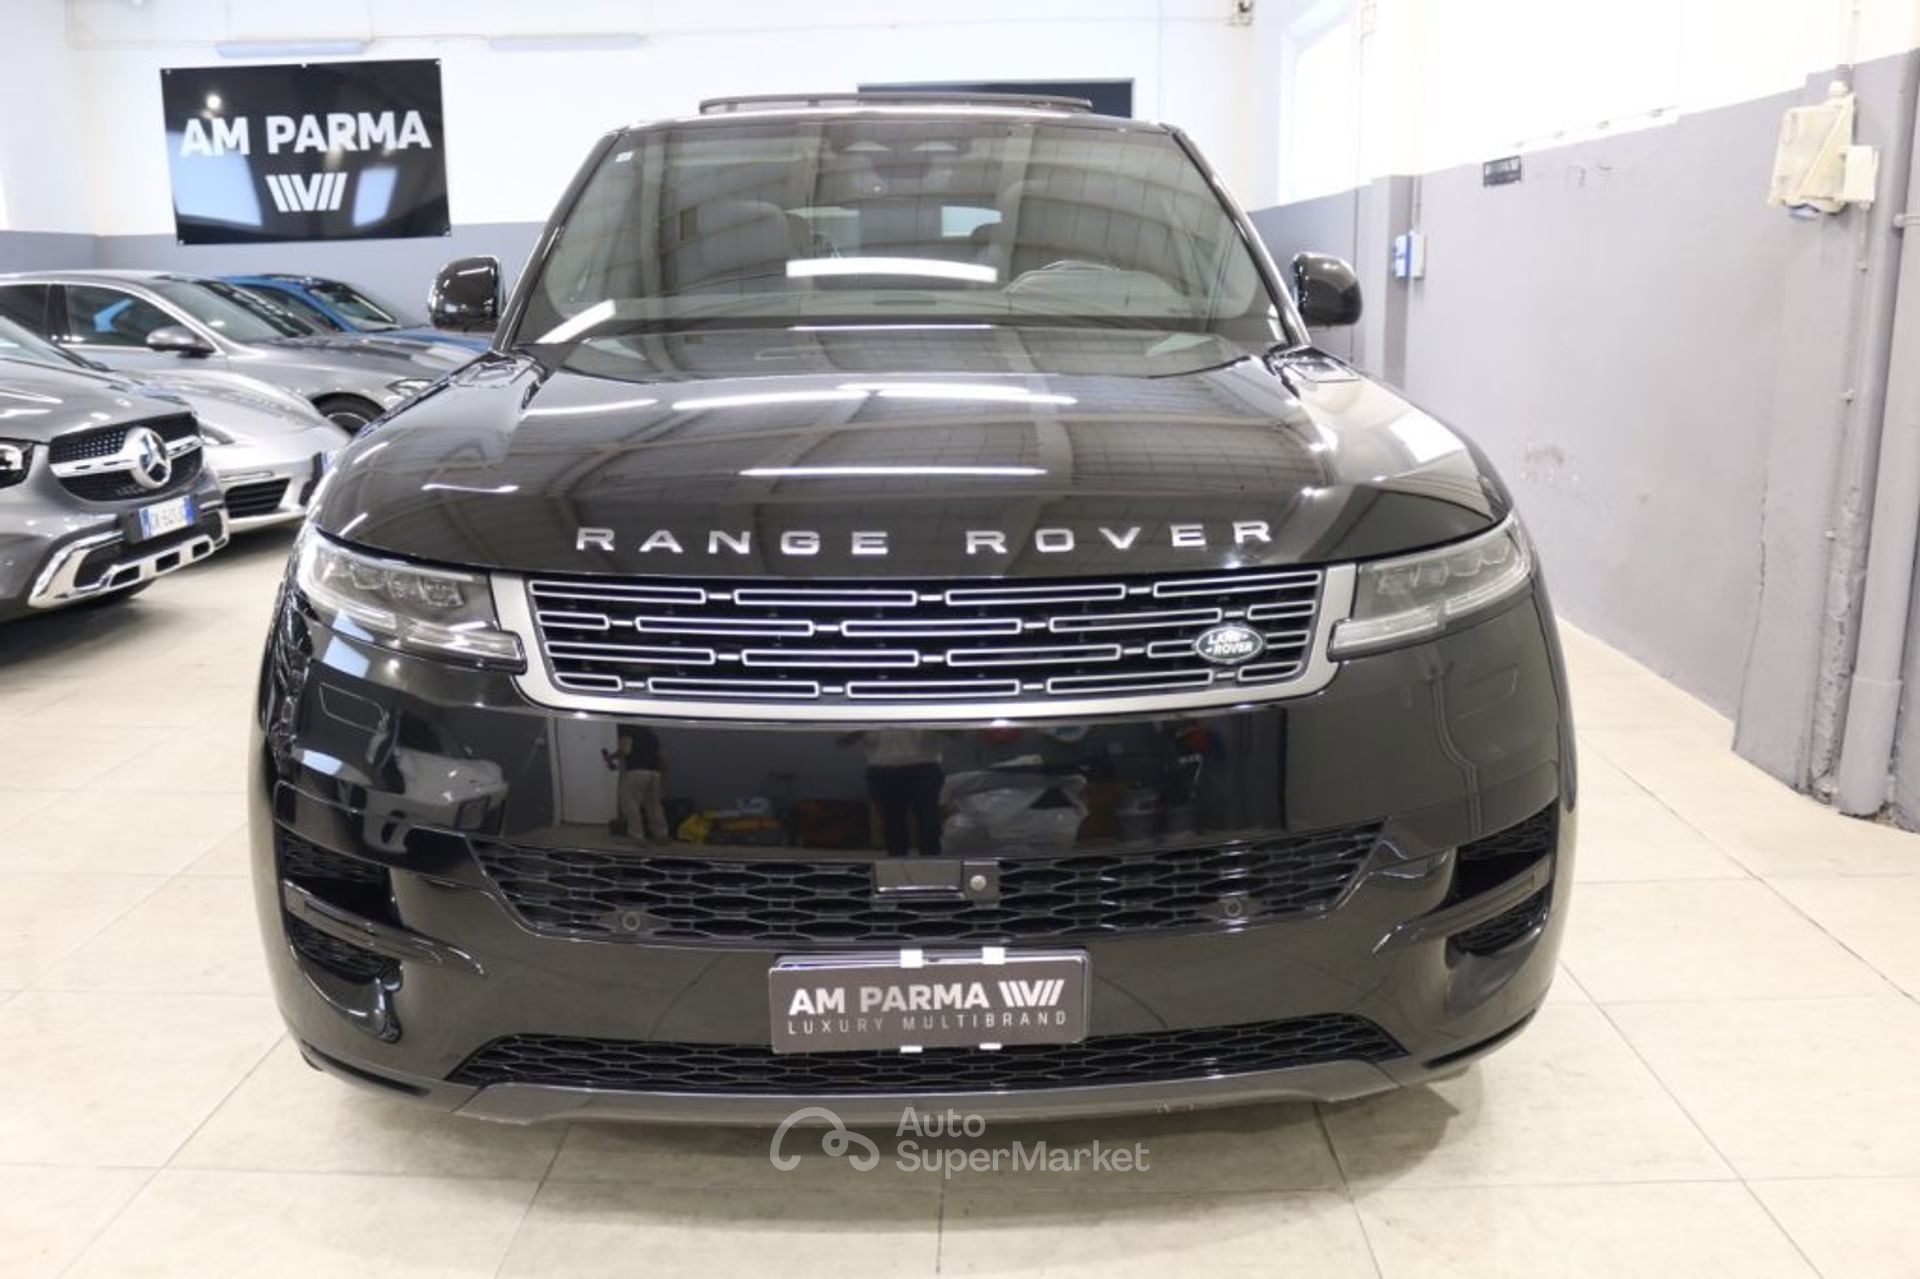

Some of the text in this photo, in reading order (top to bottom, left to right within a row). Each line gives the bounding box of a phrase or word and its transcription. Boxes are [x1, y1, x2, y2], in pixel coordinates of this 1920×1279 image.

[180, 110, 432, 156] AM PARMA
[575, 520, 1273, 555] RANGE ROVER
[788, 982, 990, 1015] AM PARMA
[788, 1010, 1066, 1035] LUXURY MULTIBRAND
